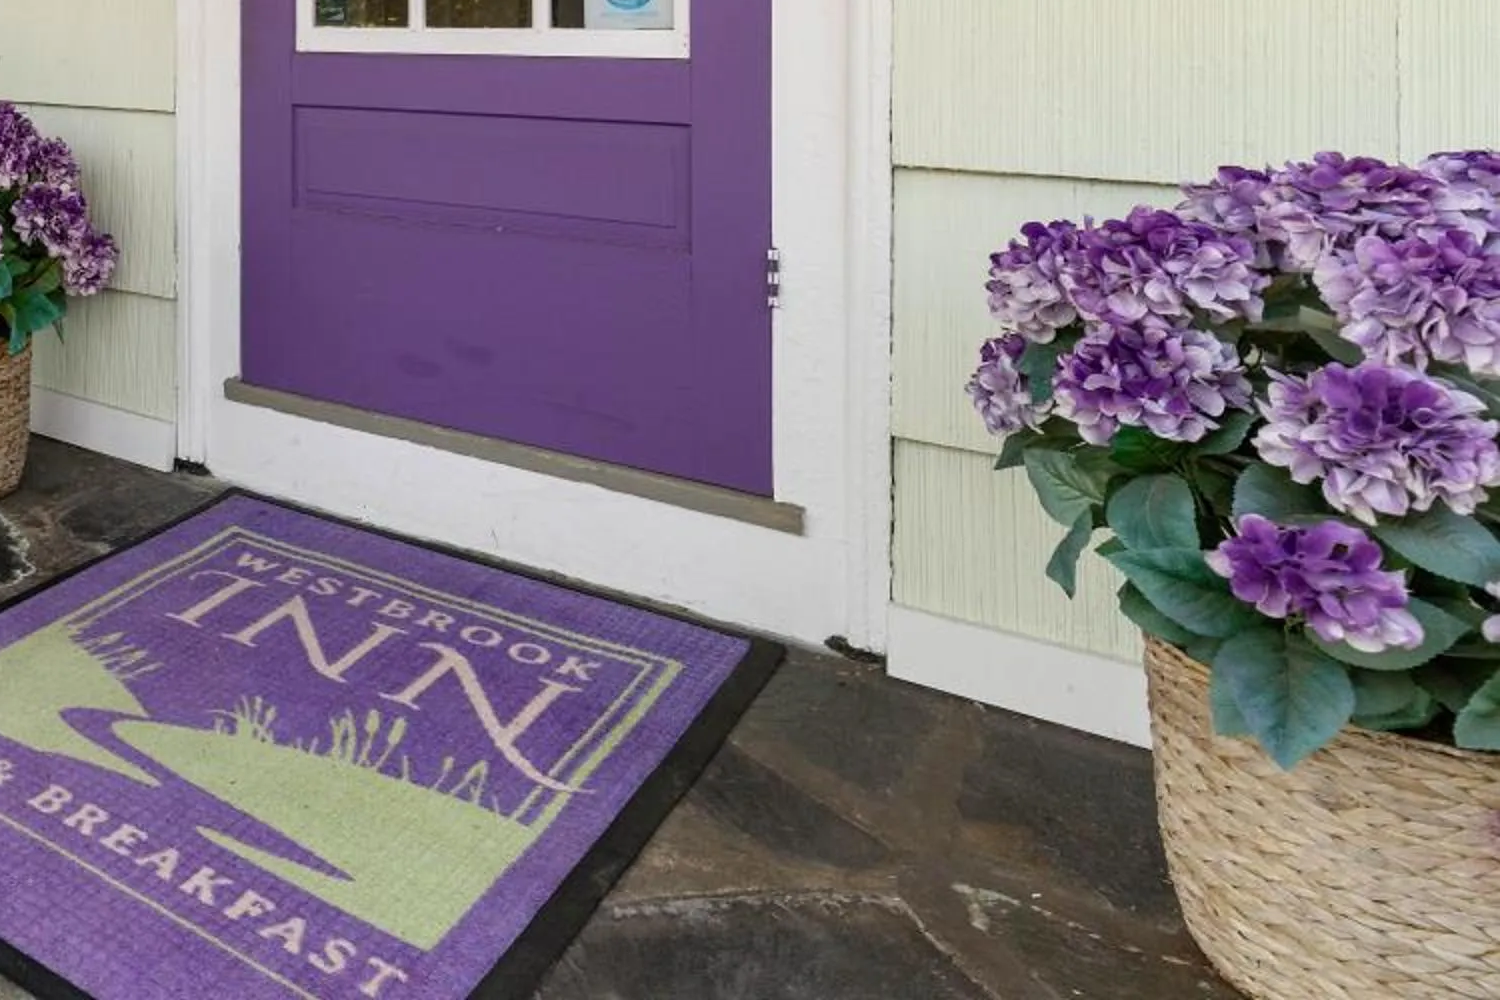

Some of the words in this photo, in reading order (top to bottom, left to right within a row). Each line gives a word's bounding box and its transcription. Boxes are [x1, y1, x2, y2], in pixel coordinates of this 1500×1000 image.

[165, 568, 597, 795] INN
[235, 552, 601, 681] WESTBROOK
[26, 783, 409, 998] BREAKFAST
